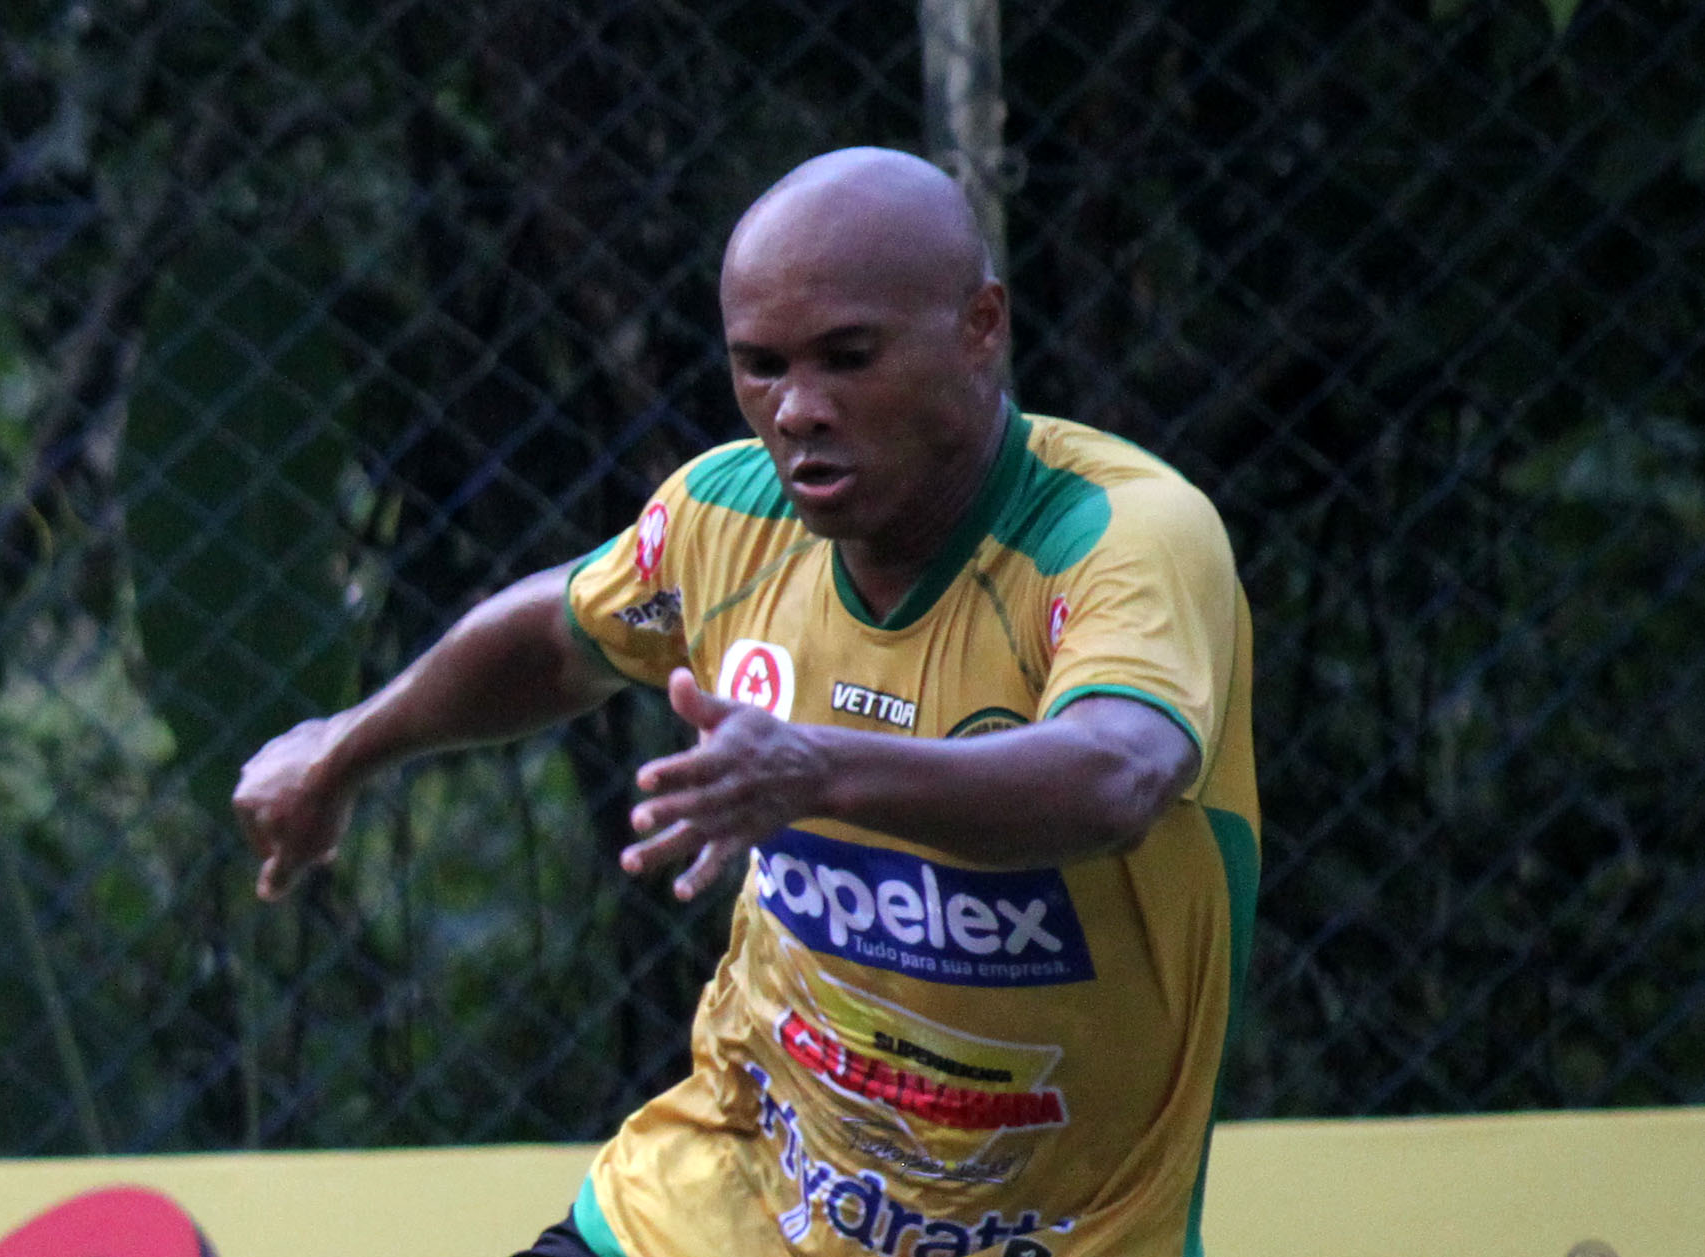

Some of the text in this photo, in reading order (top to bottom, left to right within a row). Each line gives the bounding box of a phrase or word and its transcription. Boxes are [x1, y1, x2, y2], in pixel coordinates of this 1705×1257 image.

[853, 935, 896, 960] Tudo
[901, 952, 937, 973] para
[941, 958, 973, 975] sua
